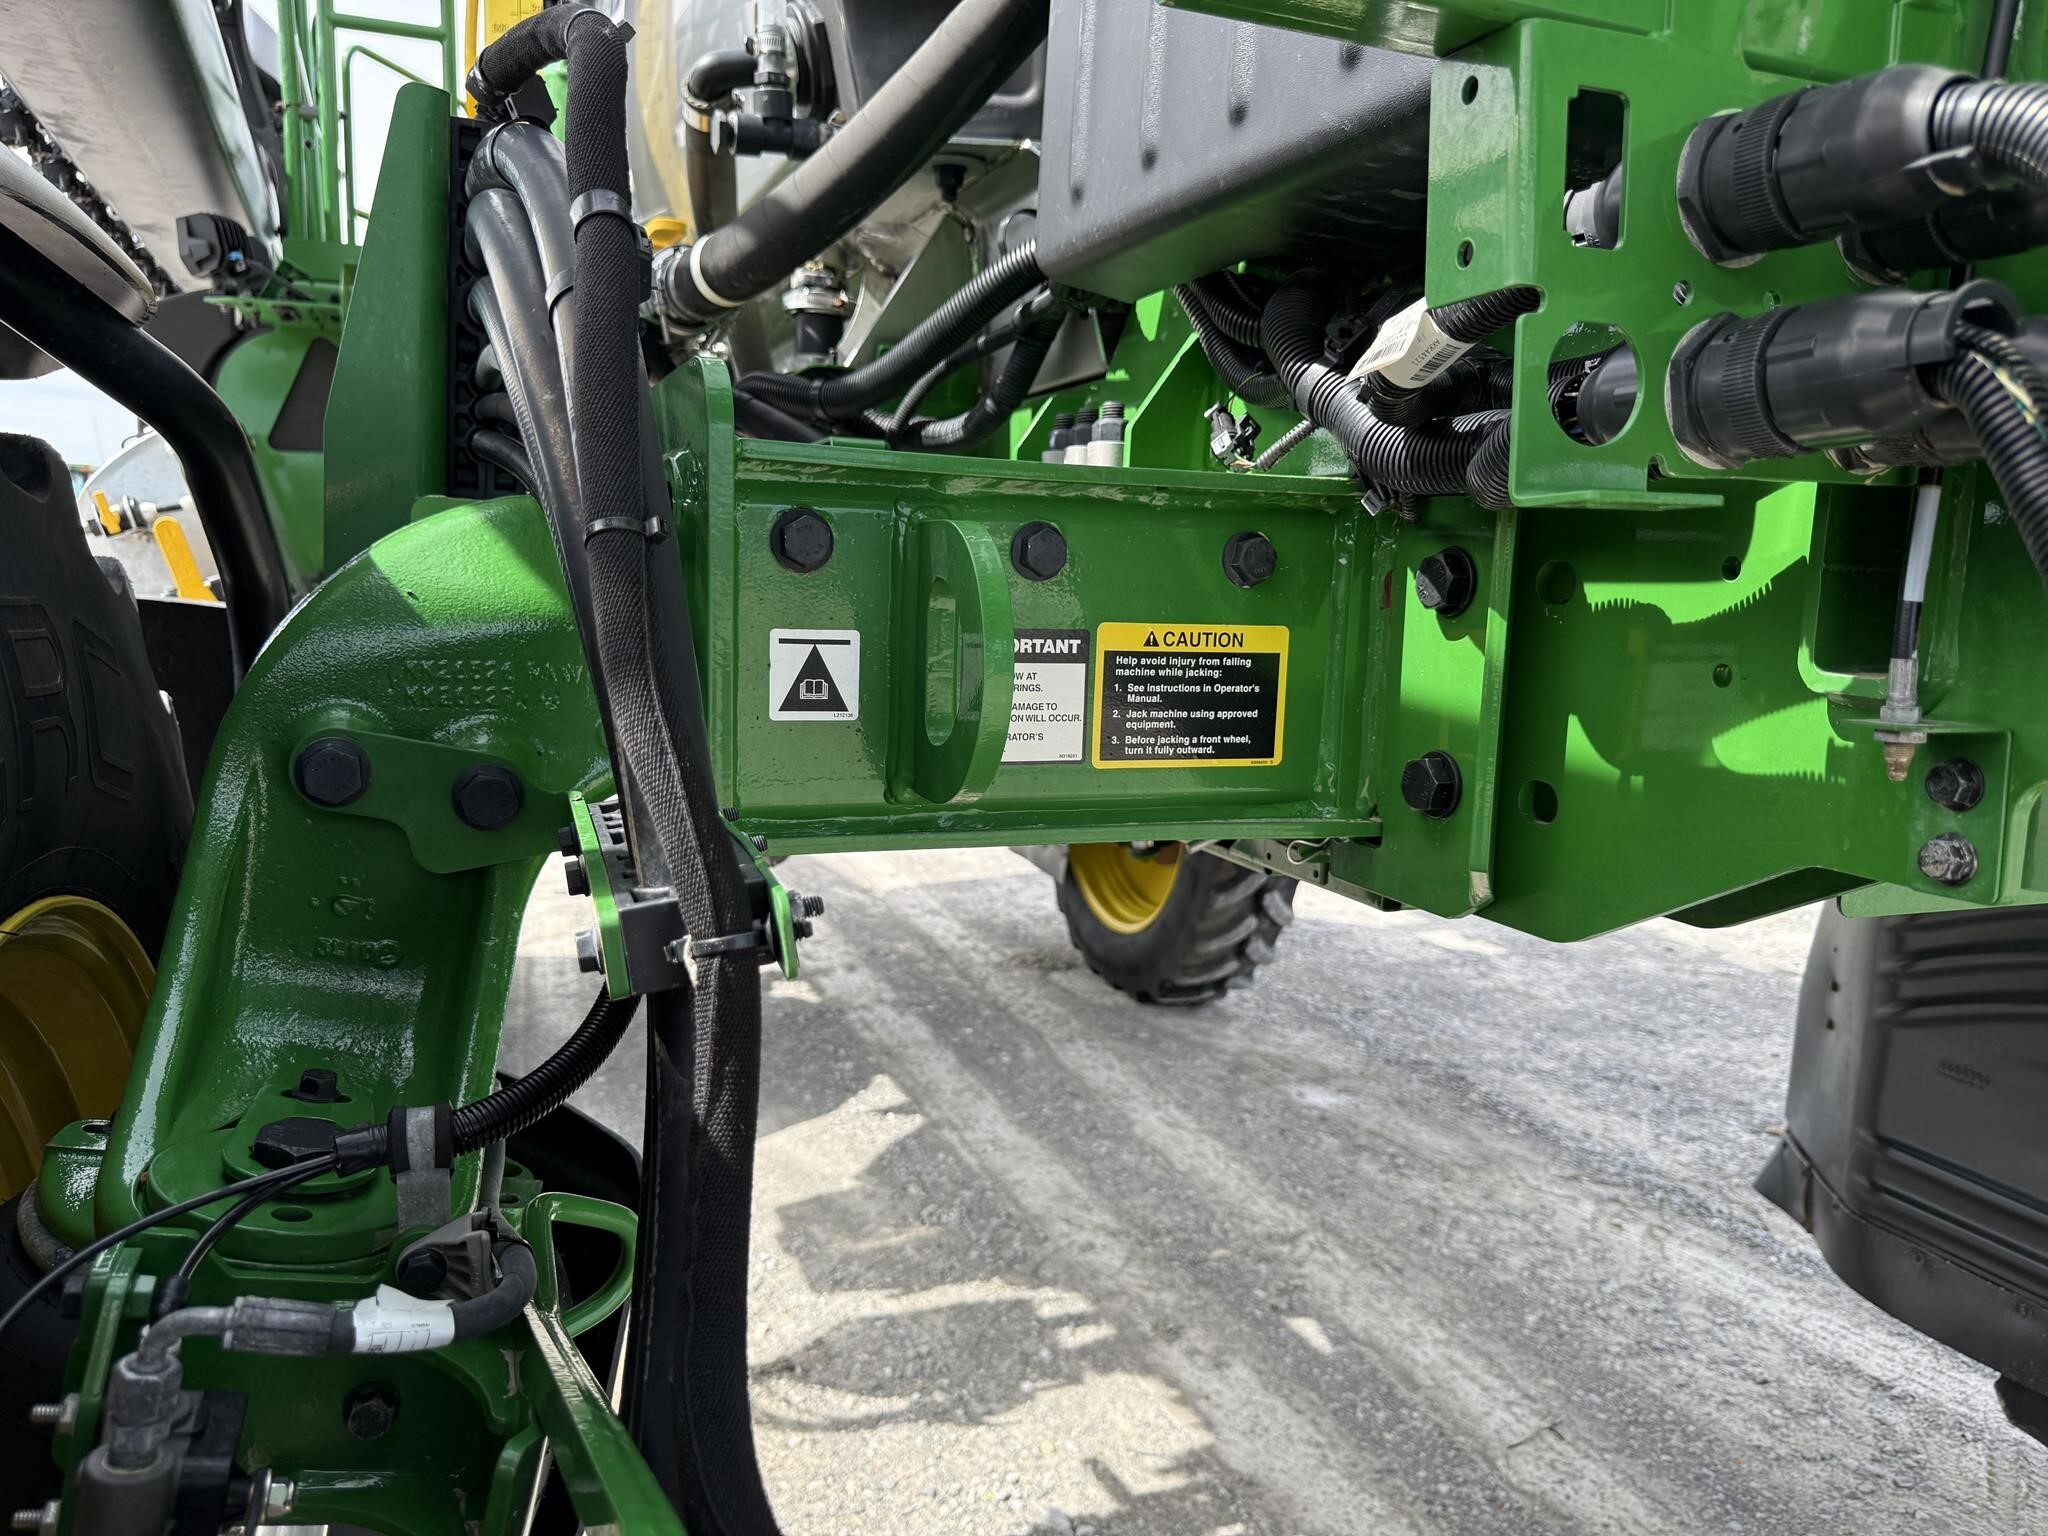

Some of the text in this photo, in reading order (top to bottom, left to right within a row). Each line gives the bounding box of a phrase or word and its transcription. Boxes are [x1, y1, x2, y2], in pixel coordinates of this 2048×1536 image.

[1163, 631, 1244, 648] CAUTION
[1116, 656, 1252, 668] Help avoid injury from falling
[1026, 672, 1038, 681] AT
[1115, 667, 1222, 679] machine while jacking:
[1013, 684, 1044, 692] RINGS.
[1114, 683, 1260, 694] 1. See instructions in Operator's
[1127, 694, 1163, 703] Manual.
[1011, 702, 1058, 711] AMAGE TO
[1010, 713, 1082, 723] ON WILL OCCUR.
[1112, 709, 1258, 720] 2. Jack machine using approved
[1125, 719, 1176, 731] equipment.
[1007, 733, 1044, 741] RATOR'S
[1111, 735, 1251, 745] 3. Before jacking a front wheel,
[1125, 745, 1215, 756] turn it fully outward.
